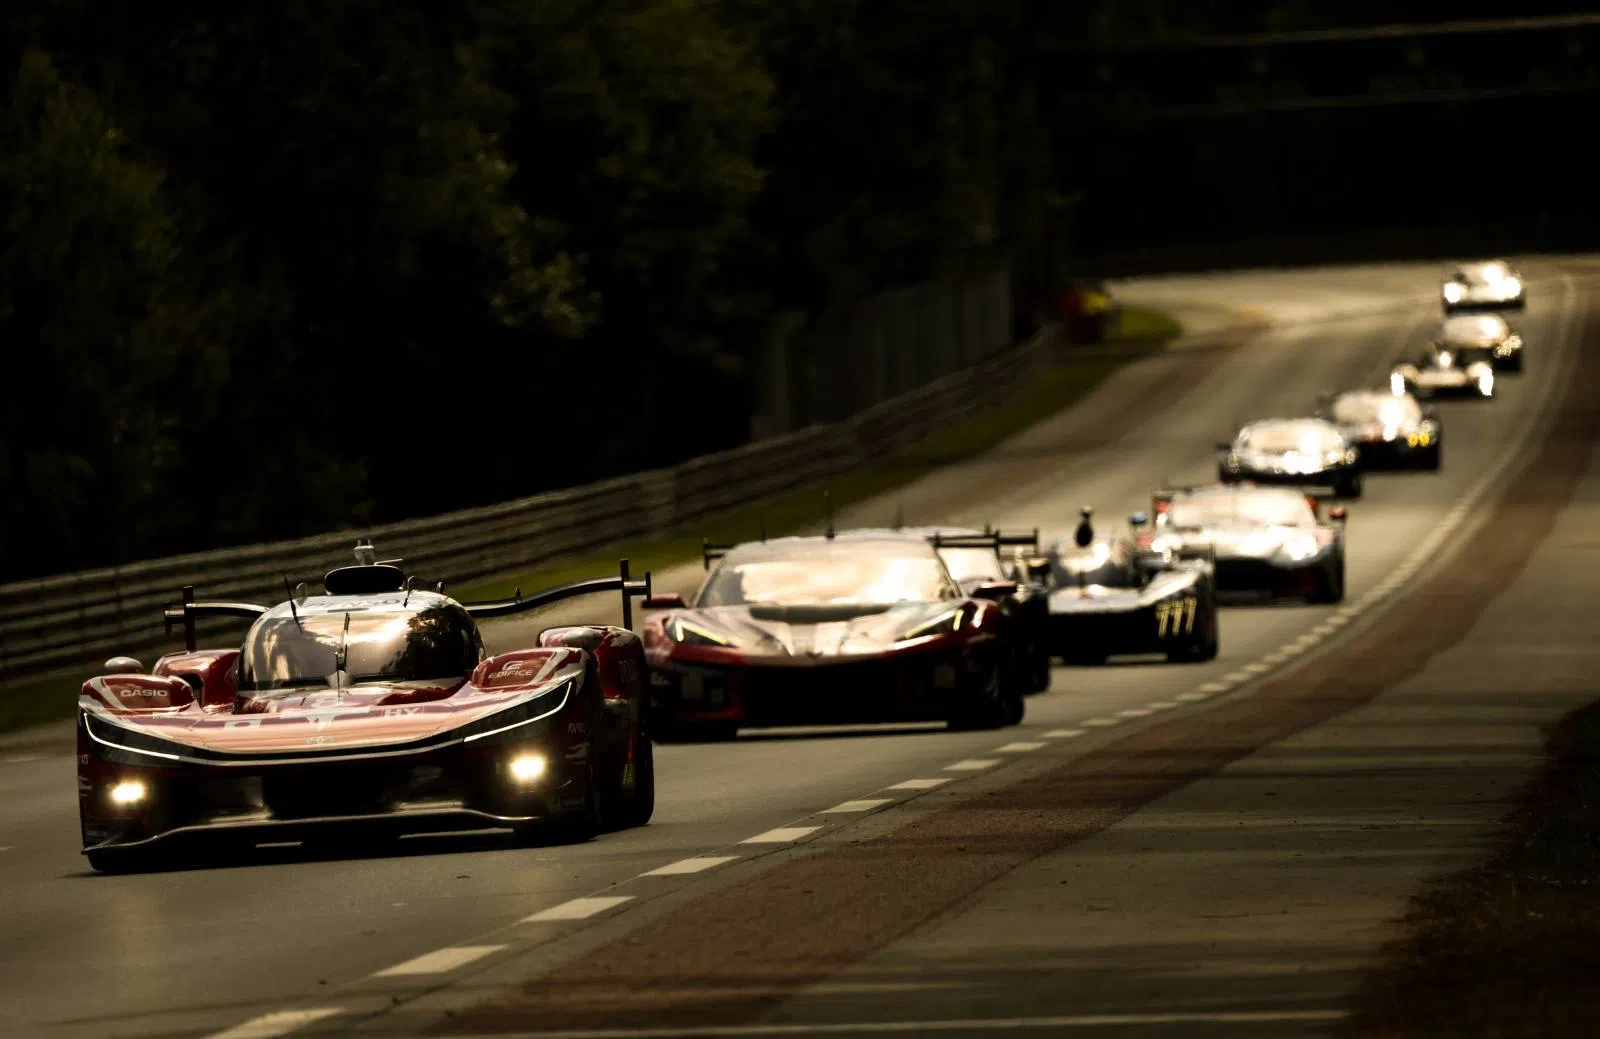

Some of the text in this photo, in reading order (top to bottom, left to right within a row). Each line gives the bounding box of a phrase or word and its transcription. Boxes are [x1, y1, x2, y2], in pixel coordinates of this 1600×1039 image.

[1155, 597, 1197, 640] 777
[488, 669, 534, 679] EDIFICE
[120, 689, 168, 698] CASIO
